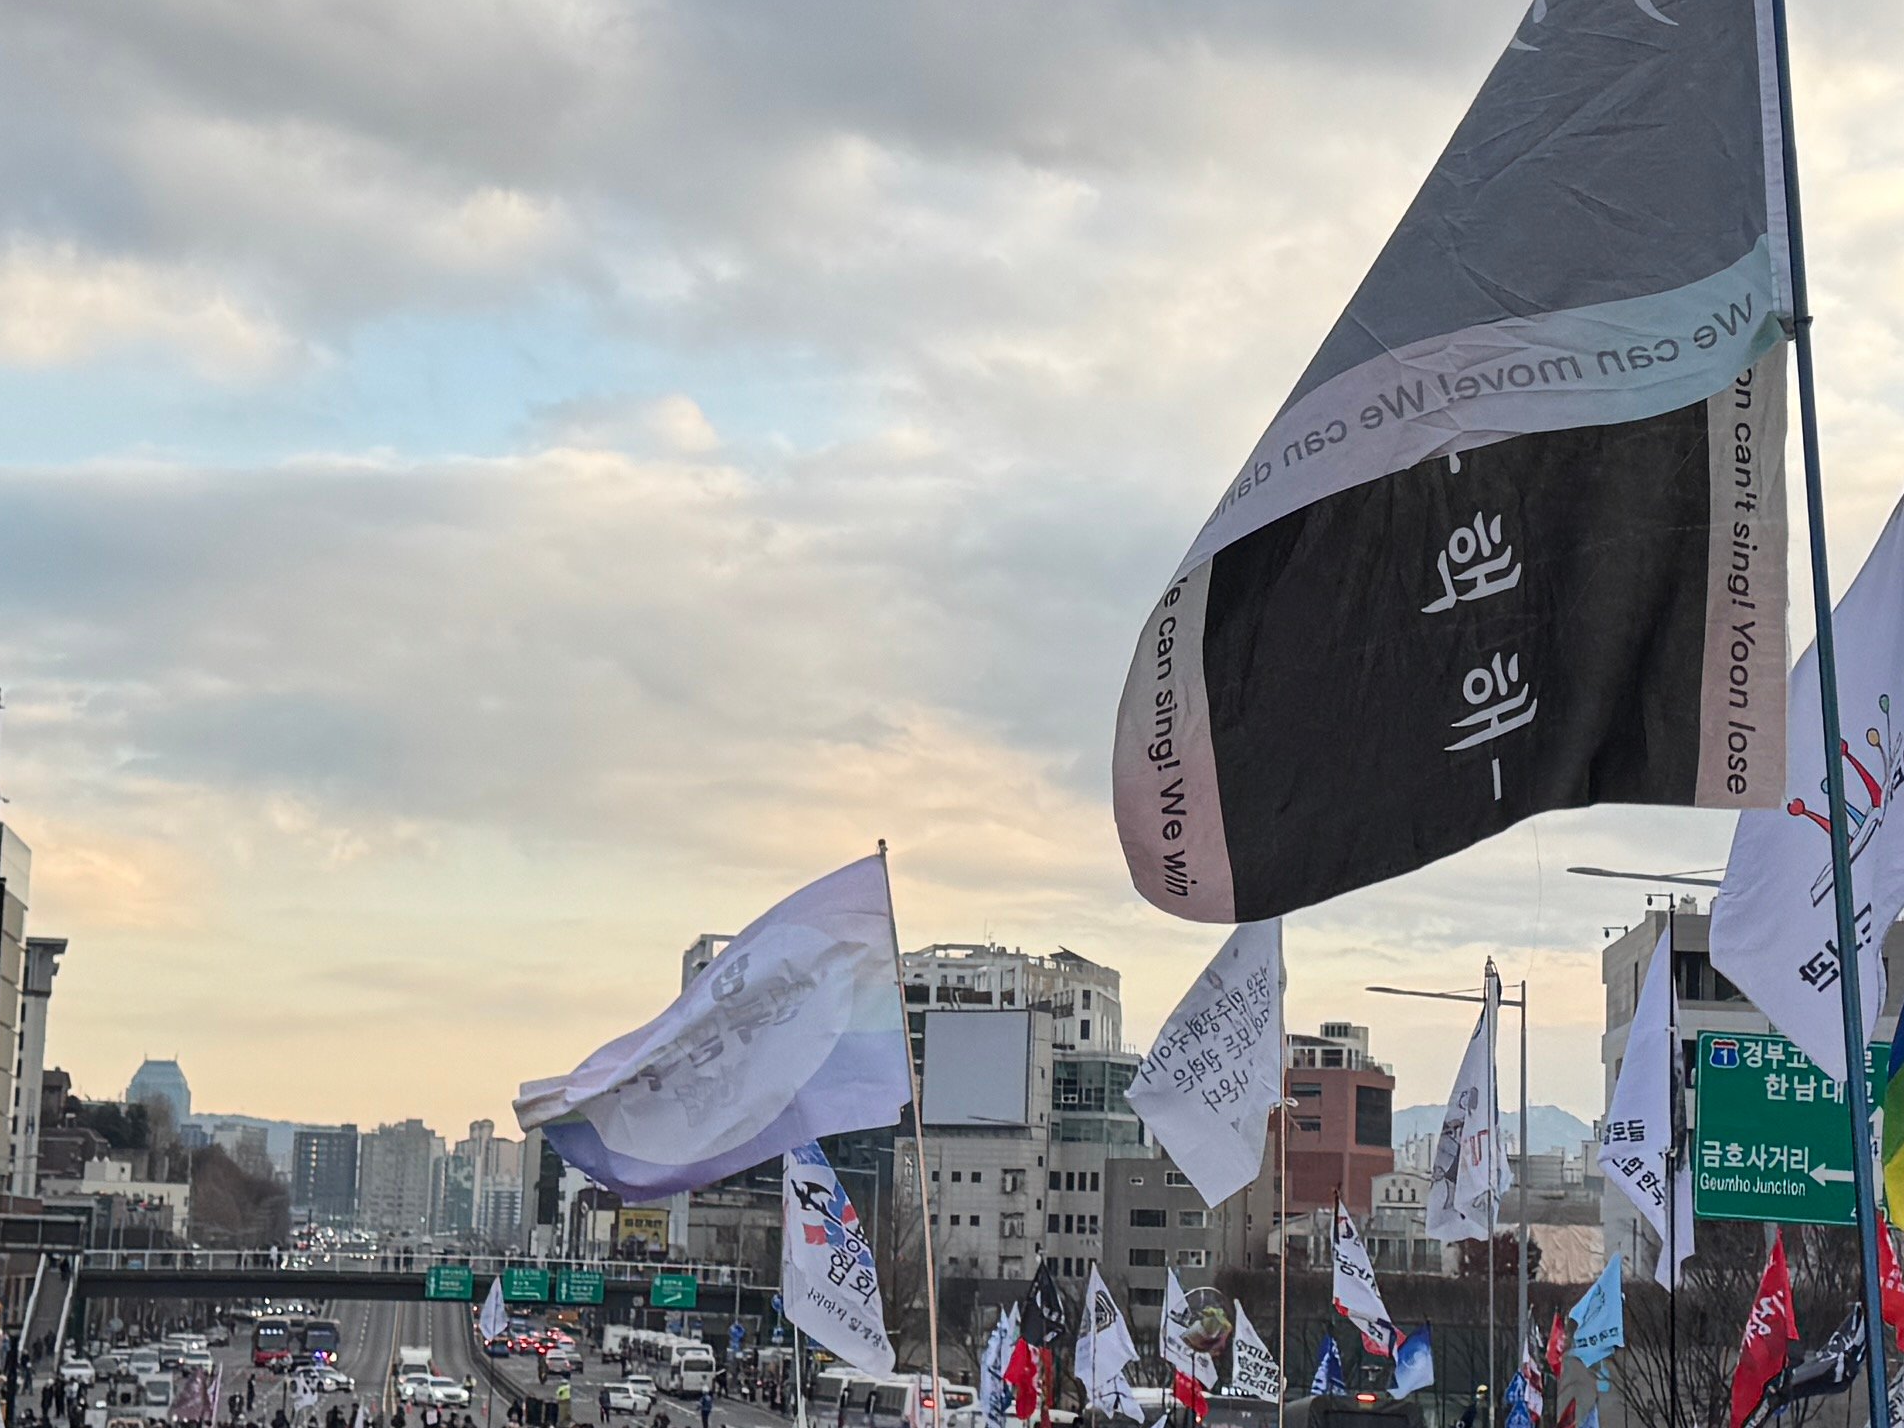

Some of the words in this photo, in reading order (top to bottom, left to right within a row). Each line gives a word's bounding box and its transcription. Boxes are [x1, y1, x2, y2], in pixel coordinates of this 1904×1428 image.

[1732, 423, 1756, 514] can't
[1729, 522, 1758, 610] sing!
[1157, 619, 1174, 675] can
[1730, 618, 1758, 713] Yoon
[1148, 684, 1179, 768] sing!
[1726, 718, 1756, 796] lose
[1154, 777, 1188, 838] We
[1164, 846, 1197, 897] win
[1700, 1175, 1750, 1193] Geumho
[1753, 1176, 1805, 1196] Junction
[1701, 1141, 1809, 1174] 금호사거리
